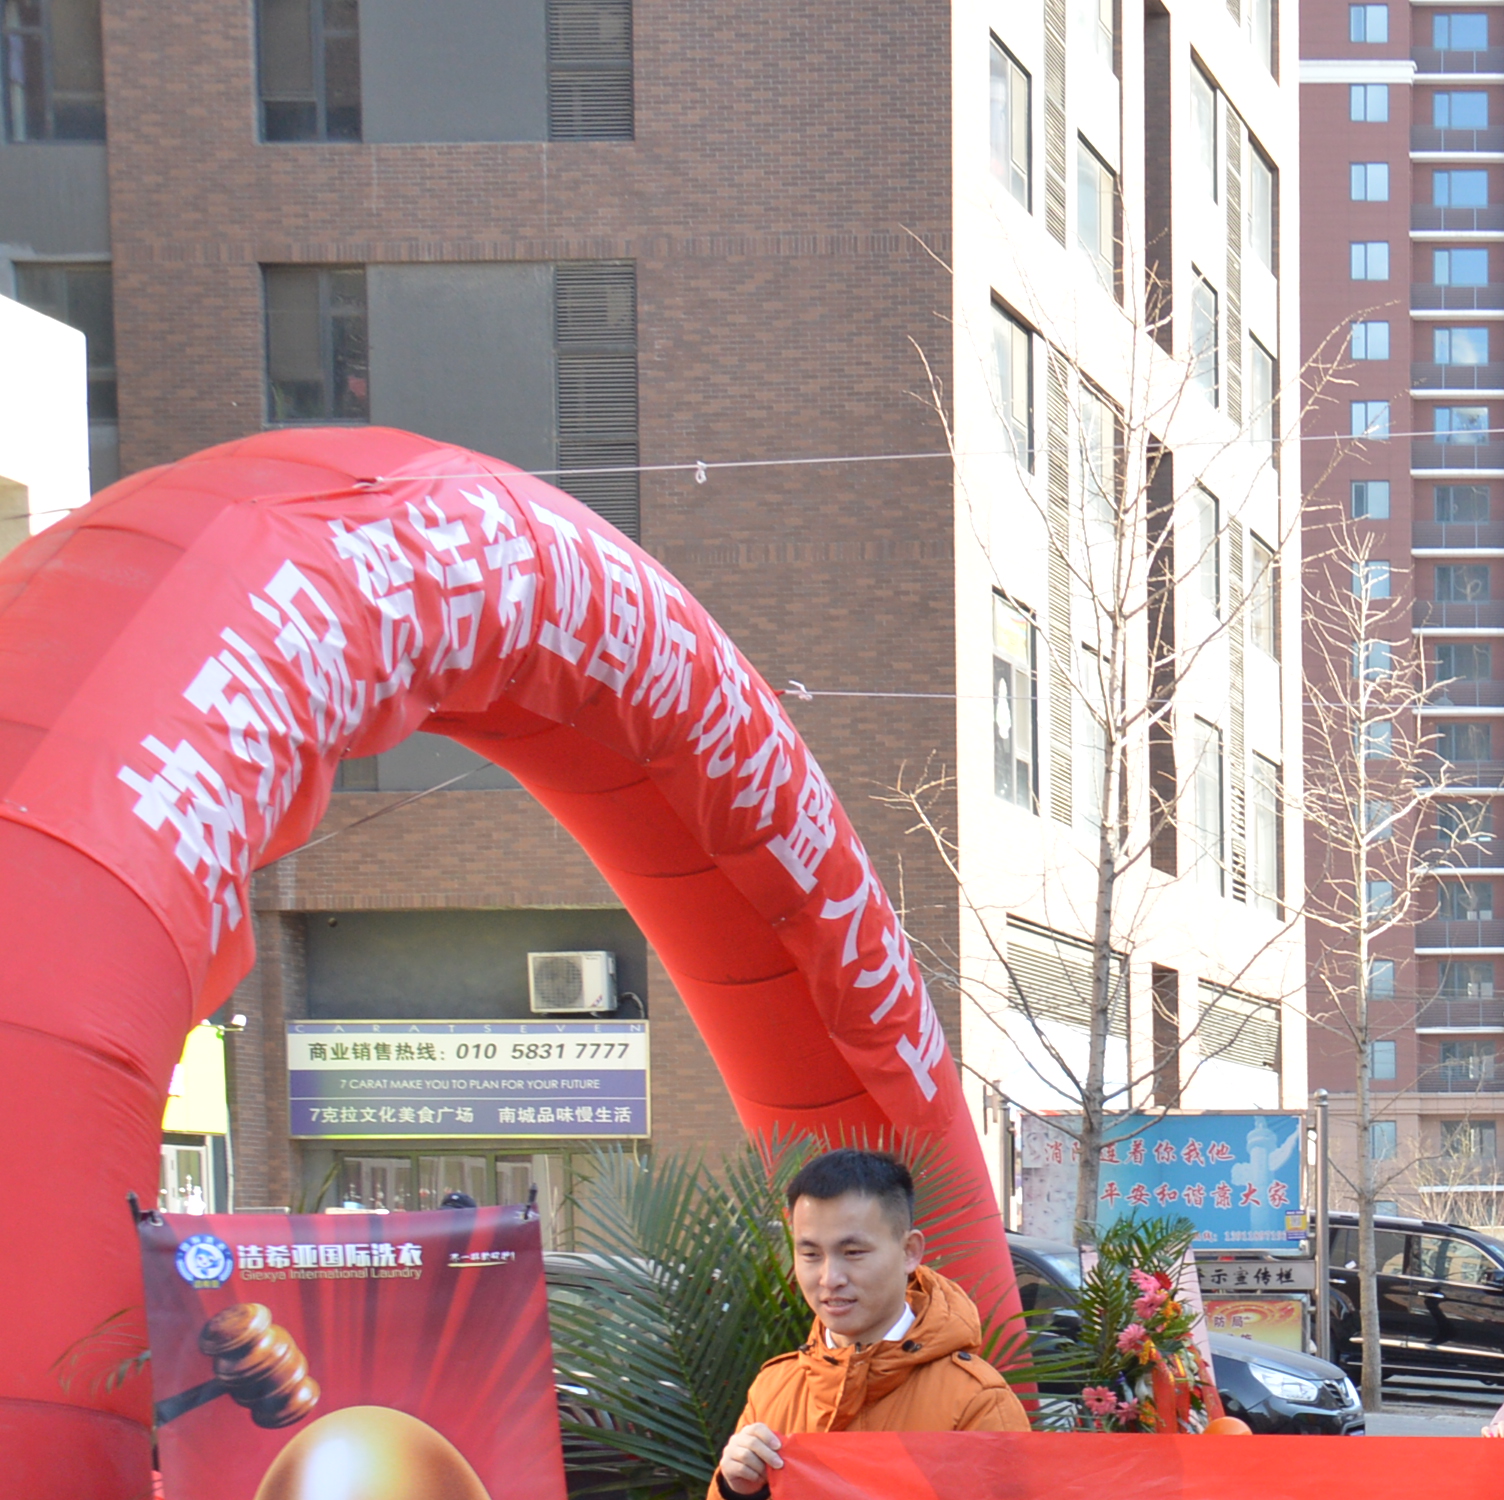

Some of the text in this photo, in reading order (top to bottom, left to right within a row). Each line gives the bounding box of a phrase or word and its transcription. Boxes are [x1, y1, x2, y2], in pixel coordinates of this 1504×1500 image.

[455, 1042, 498, 1060] 010
[510, 1042, 565, 1060] 5831
[575, 1042, 630, 1060] 7777
[349, 1079, 388, 1090] CARAT
[390, 1079, 423, 1090] MAKE
[424, 1079, 449, 1090] YOU
[451, 1079, 468, 1090] TO
[469, 1079, 499, 1090] PLAN
[501, 1079, 525, 1090] FOR
[526, 1079, 558, 1090] YOUR
[561, 1079, 601, 1090] FUTURE
[309, 1106, 632, 1124] 7克拉文化美食广场 南城品味慢生活
[1043, 1138, 1236, 1166] 消连着你我他
[236, 1242, 423, 1270] 洁希亚国际洗衣
[290, 1268, 369, 1280] International
[371, 1267, 423, 1280] Laundry
